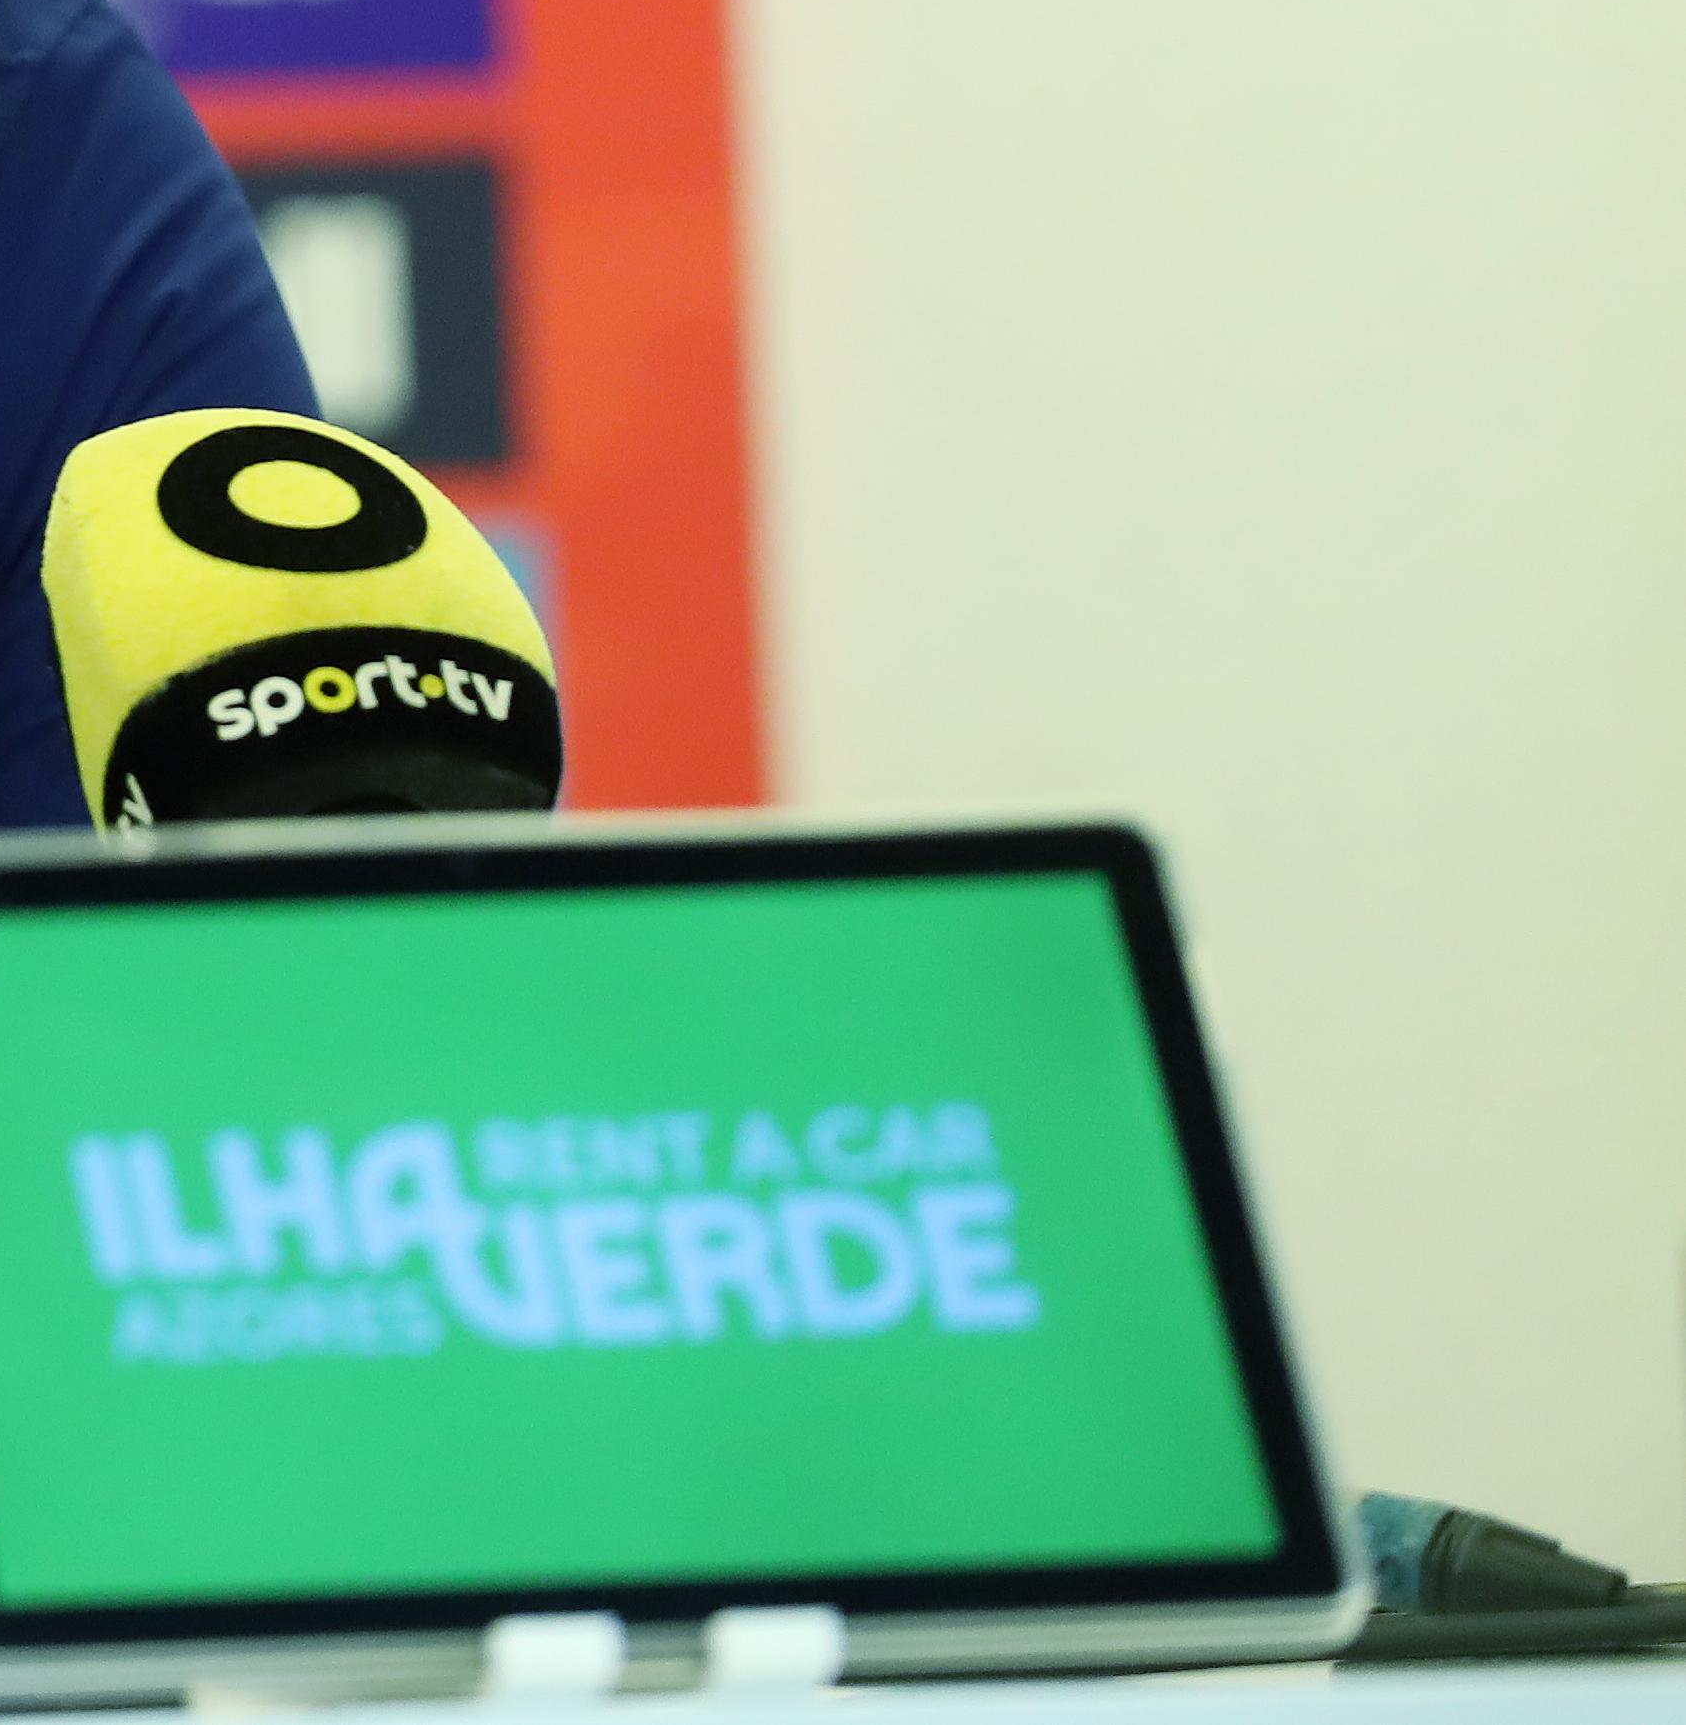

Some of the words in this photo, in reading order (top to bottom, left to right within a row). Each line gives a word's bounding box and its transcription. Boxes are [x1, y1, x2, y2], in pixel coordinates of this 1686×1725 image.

[68, 1120, 458, 1285] ILHA
[729, 1110, 801, 1184] A
[801, 1101, 1001, 1182] CAR
